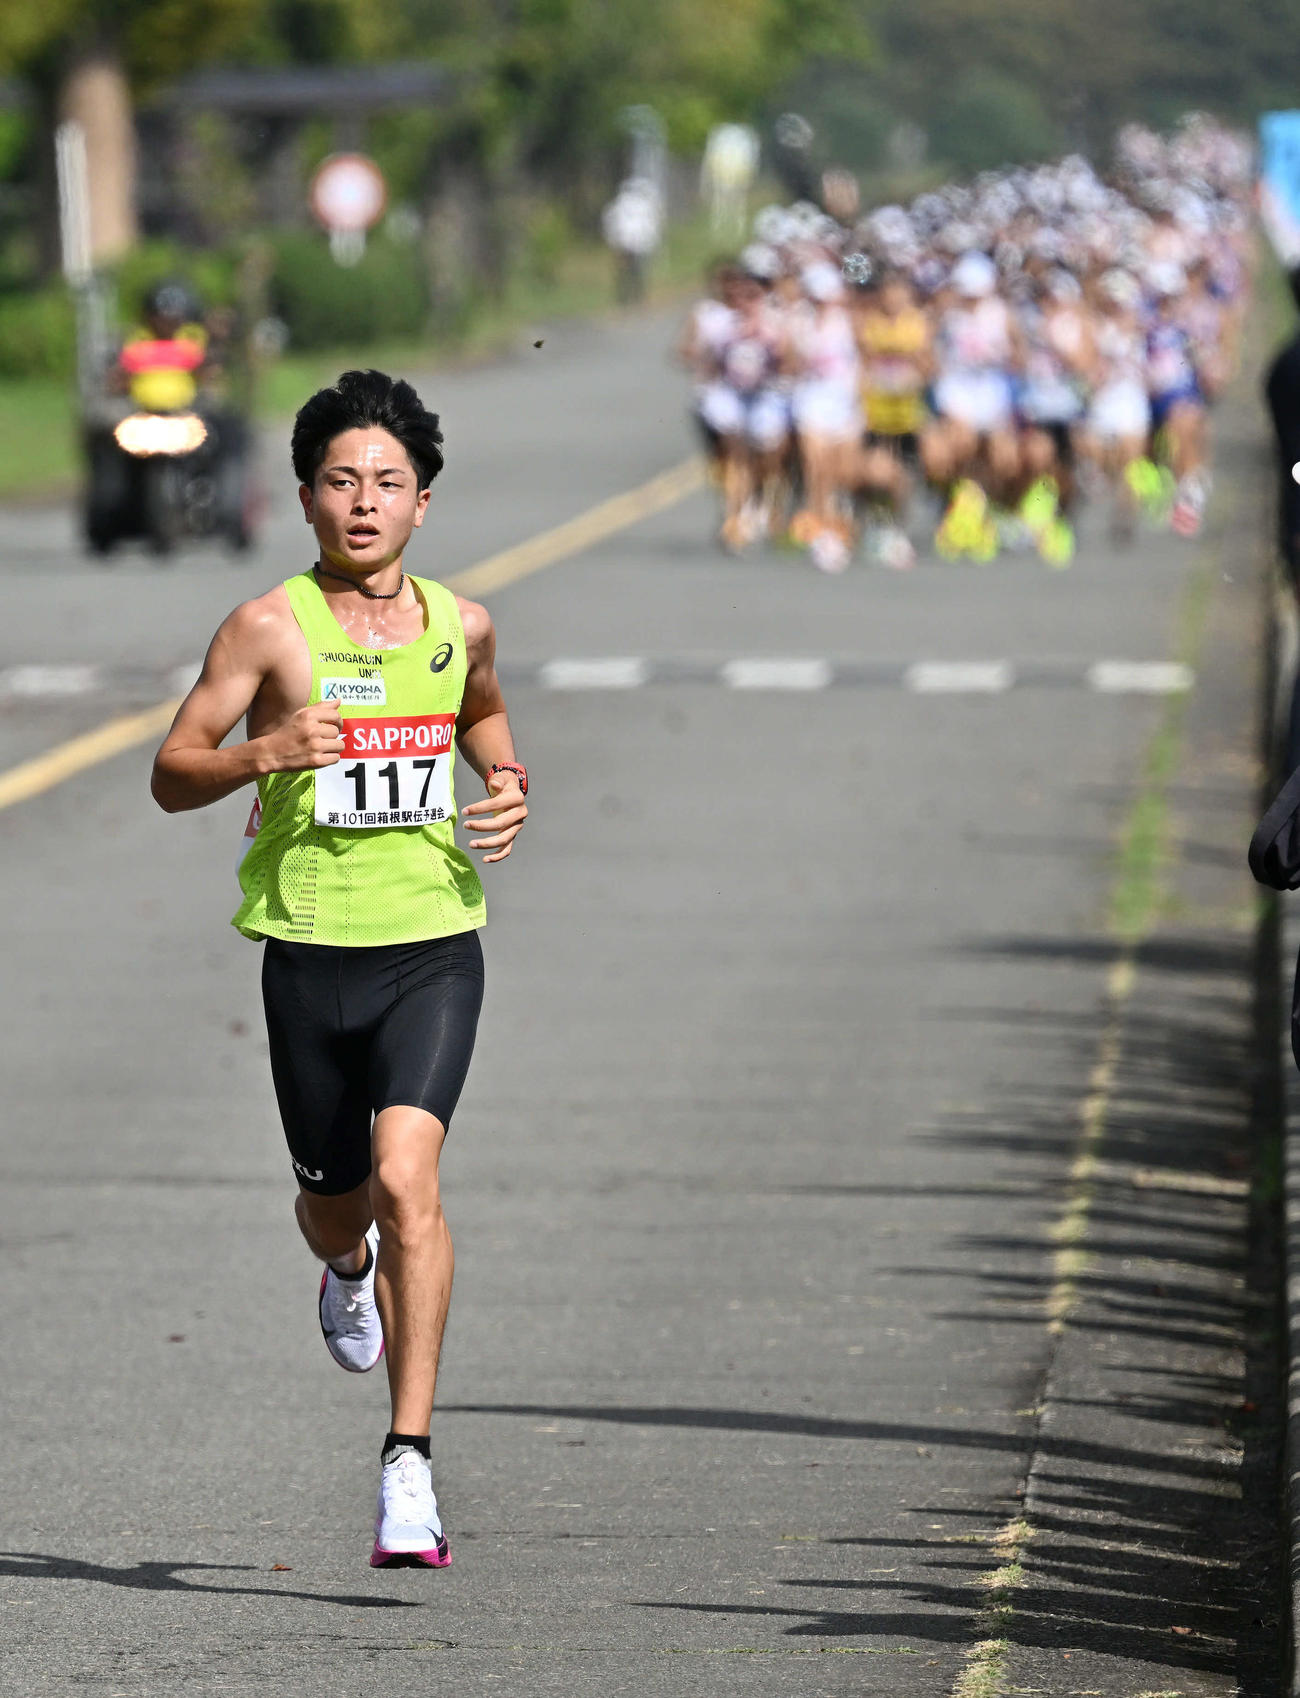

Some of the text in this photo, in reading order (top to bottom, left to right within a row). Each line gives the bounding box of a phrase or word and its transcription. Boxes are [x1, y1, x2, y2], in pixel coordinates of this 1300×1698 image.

[339, 683, 382, 695] KYOWA
[355, 724, 452, 752] SAPPORO
[346, 759, 437, 811] 117
[328, 807, 446, 825] 第101回箱根駅伝予選会
